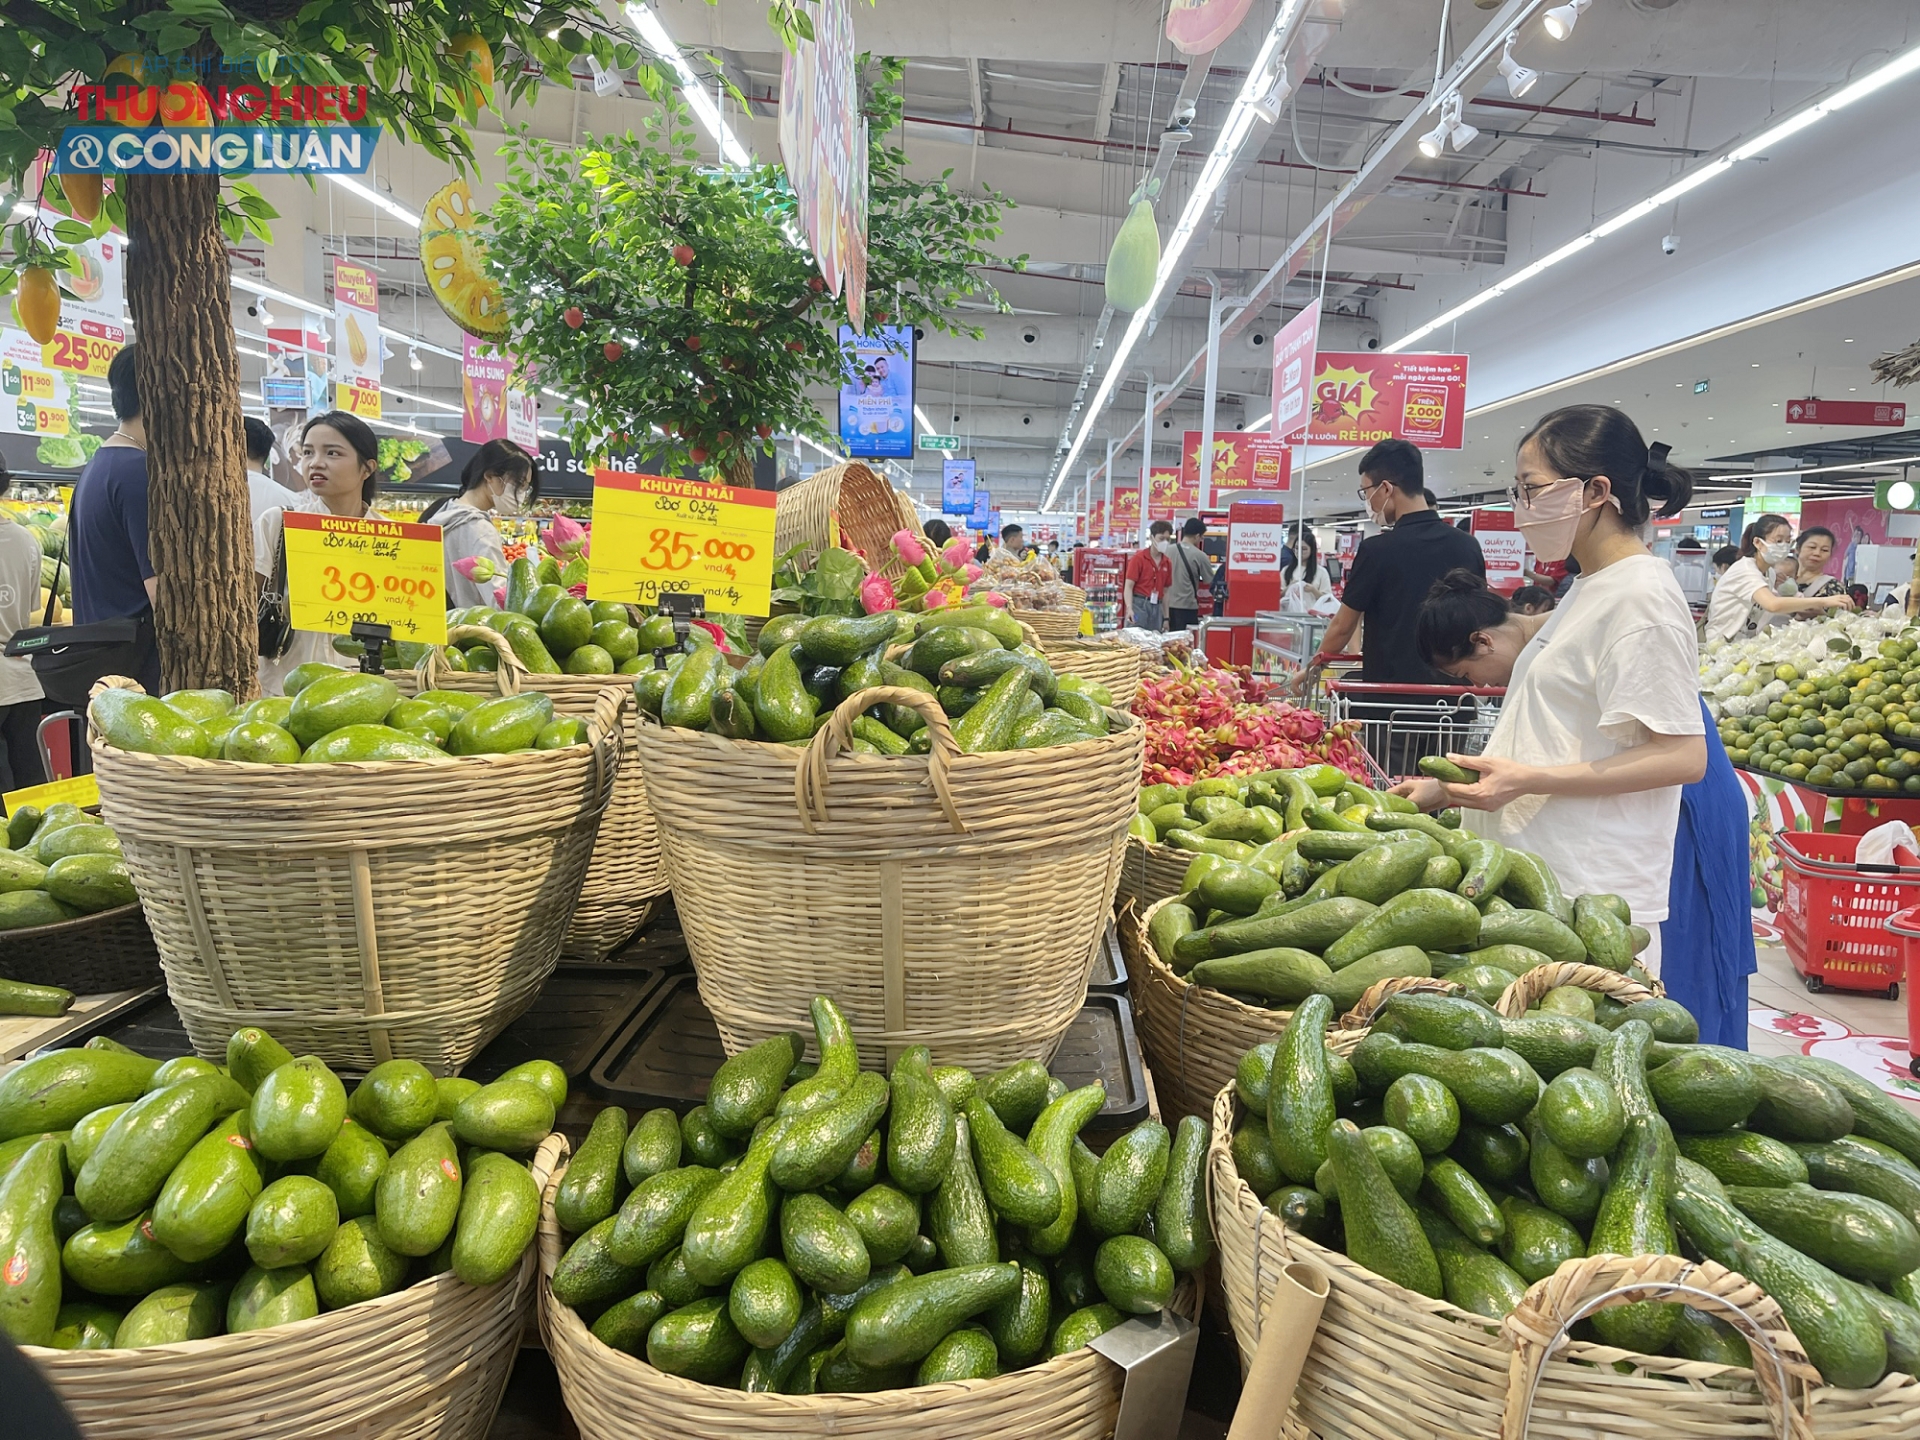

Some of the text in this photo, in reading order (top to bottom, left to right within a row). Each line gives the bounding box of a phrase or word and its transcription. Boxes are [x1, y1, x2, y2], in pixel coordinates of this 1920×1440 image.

[338, 270, 365, 287] Khuyến
[466, 360, 505, 381] GIẢM SUNG
[1418, 366, 1436, 374] kiệm
[3, 370, 10, 387] 1
[22, 375, 51, 391] 11.900
[1408, 374, 1426, 382] ngày
[1427, 374, 1446, 382] cùng
[1446, 374, 1461, 382] GO!
[349, 388, 378, 412] 7.000
[1317, 379, 1367, 408] GIÁ
[1417, 397, 1435, 406] TRÊN
[18, 409, 27, 427] 3
[1406, 406, 1443, 418] 2.000
[1315, 432, 1337, 441] LUÔN
[1339, 427, 1359, 441] RẺ
[1361, 428, 1393, 441] HƠN
[1153, 480, 1175, 492] GIÁ
[1215, 476, 1227, 486] RẺ
[1227, 478, 1248, 486] HƠN
[640, 479, 735, 502] KHUYẾN MÃI
[689, 499, 720, 515] 034
[321, 519, 403, 537] KHUYẾN MÃI
[1262, 531, 1273, 540] TỰ
[640, 528, 756, 572] 35.000
[1259, 540, 1278, 548] TOÁN
[1505, 538, 1516, 548] TỰ
[1481, 547, 1501, 555] HANH
[321, 565, 436, 604] 39.000
